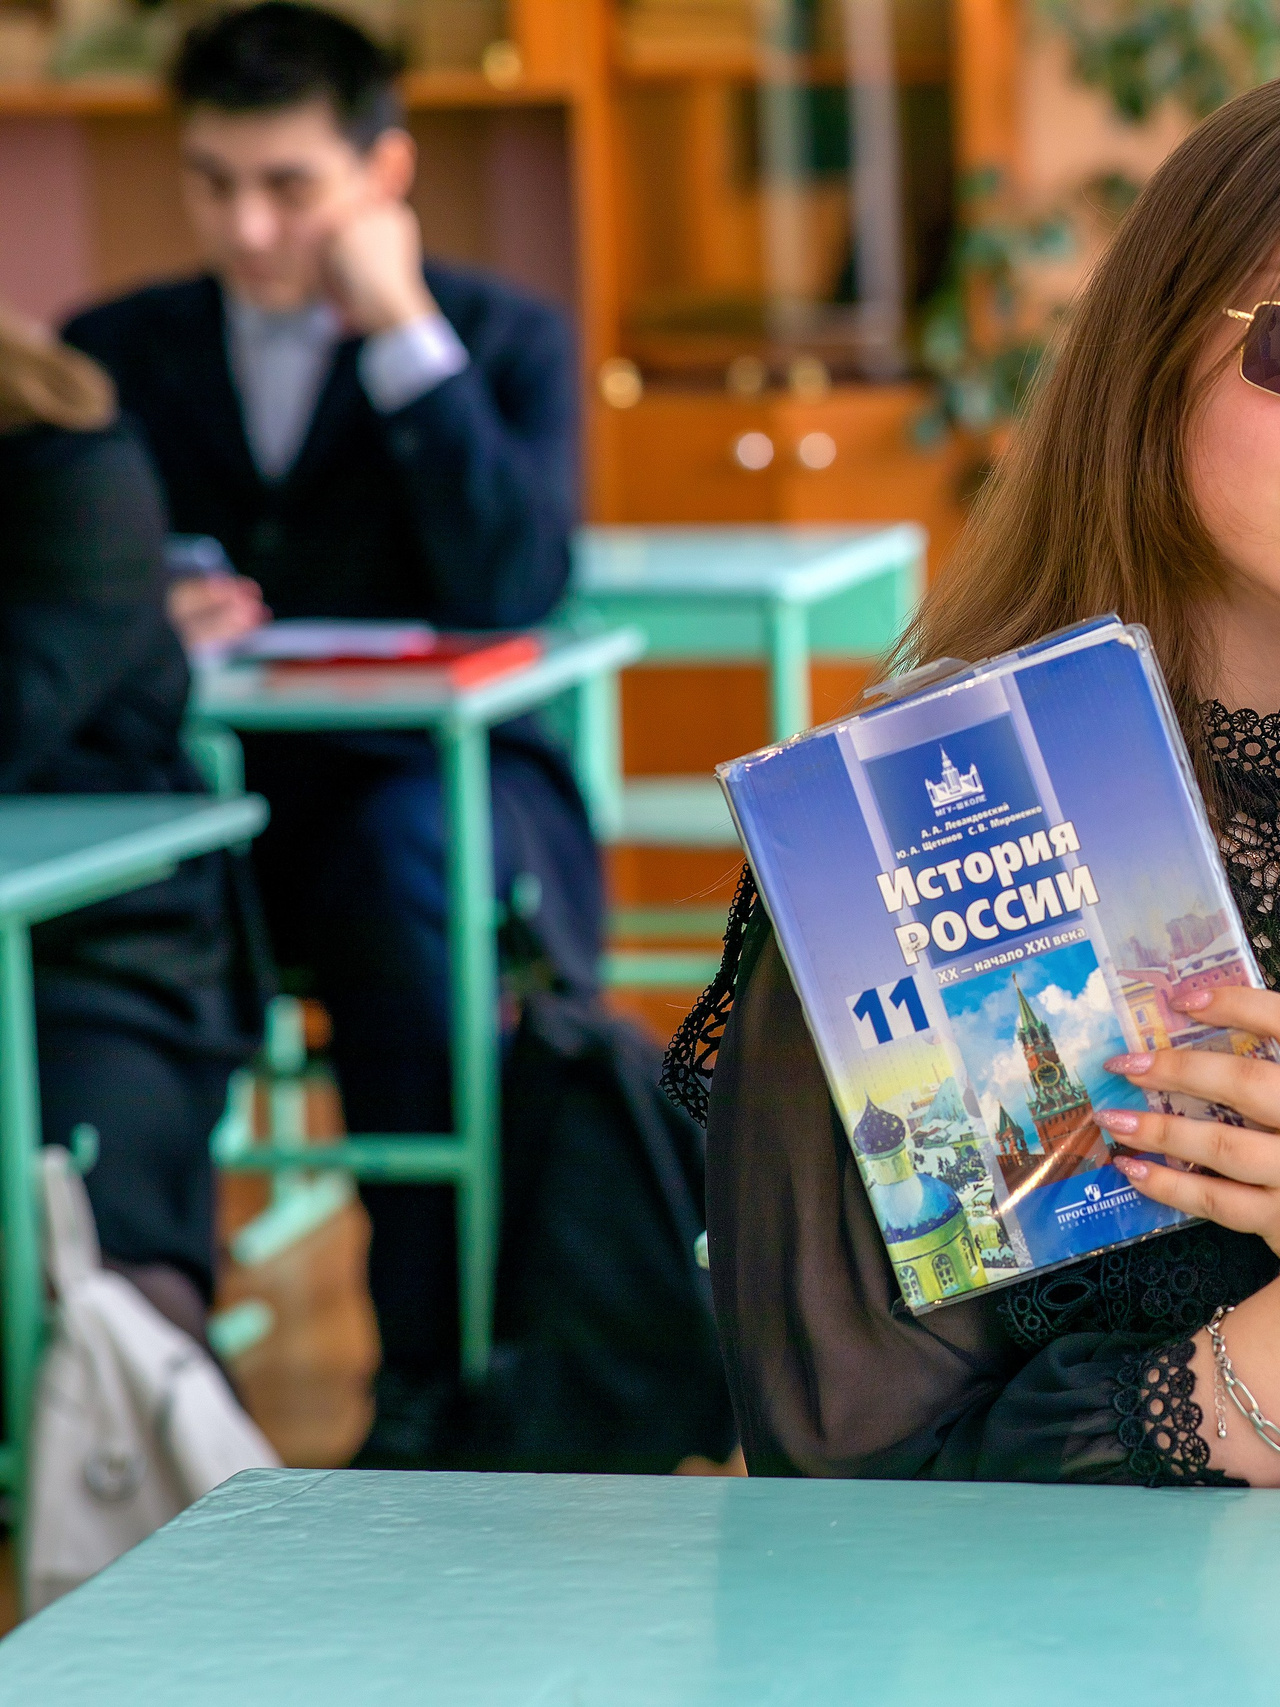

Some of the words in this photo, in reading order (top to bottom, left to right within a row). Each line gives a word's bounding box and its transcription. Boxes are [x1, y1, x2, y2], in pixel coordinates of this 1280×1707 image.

[921, 832, 963, 851] Щетинов
[989, 805, 1043, 829] Мироненко
[944, 802, 1010, 831] Левандовский
[876, 820, 1081, 914] История
[894, 864, 1101, 966] РОССИИ
[974, 947, 1024, 972] начало
[1052, 927, 1087, 947] века
[852, 975, 930, 1045] 11
[1057, 1191, 1139, 1224] ПРОСВЕЩЕНИЕ
